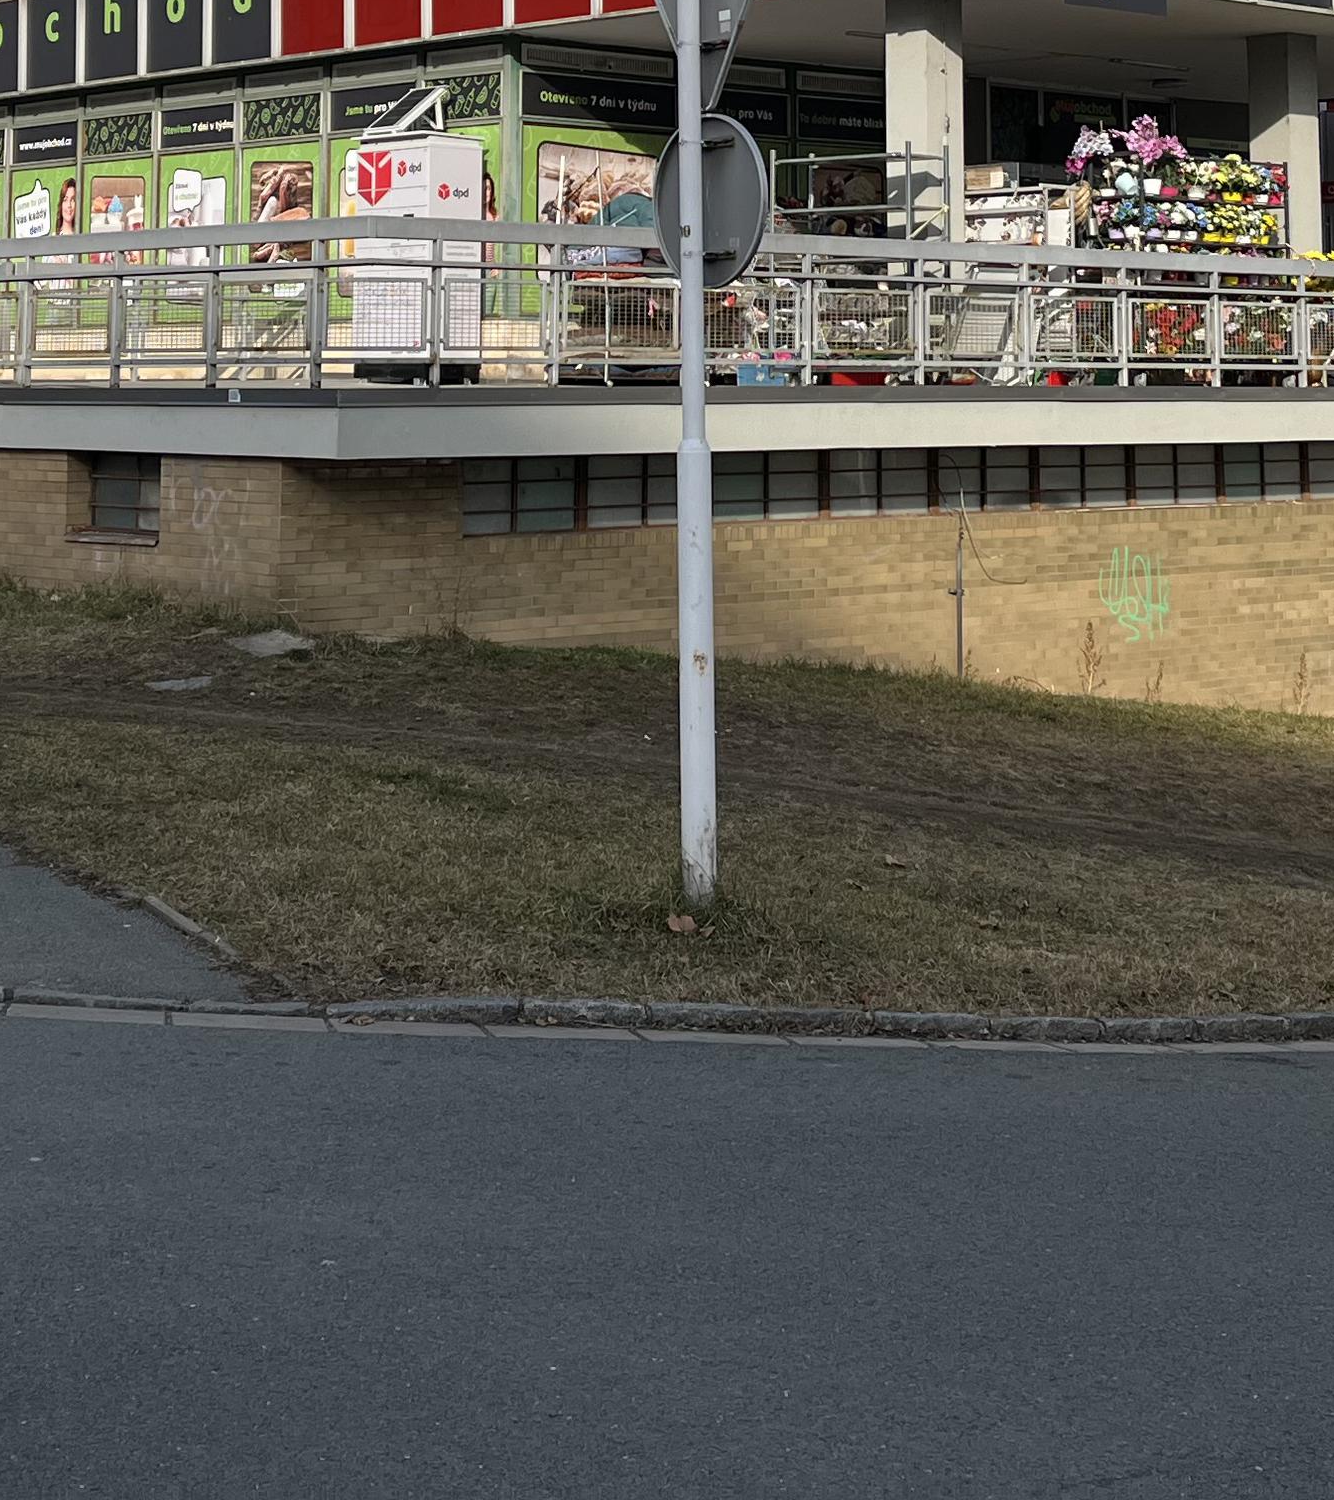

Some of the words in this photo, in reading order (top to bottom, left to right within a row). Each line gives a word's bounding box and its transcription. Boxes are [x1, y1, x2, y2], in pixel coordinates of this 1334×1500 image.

[590, 95, 598, 106] 7
[618, 99, 626, 109] v
[374, 103, 387, 115] pro
[738, 109, 755, 120] pro
[408, 161, 422, 174] dpd
[452, 187, 470, 200] dpd
